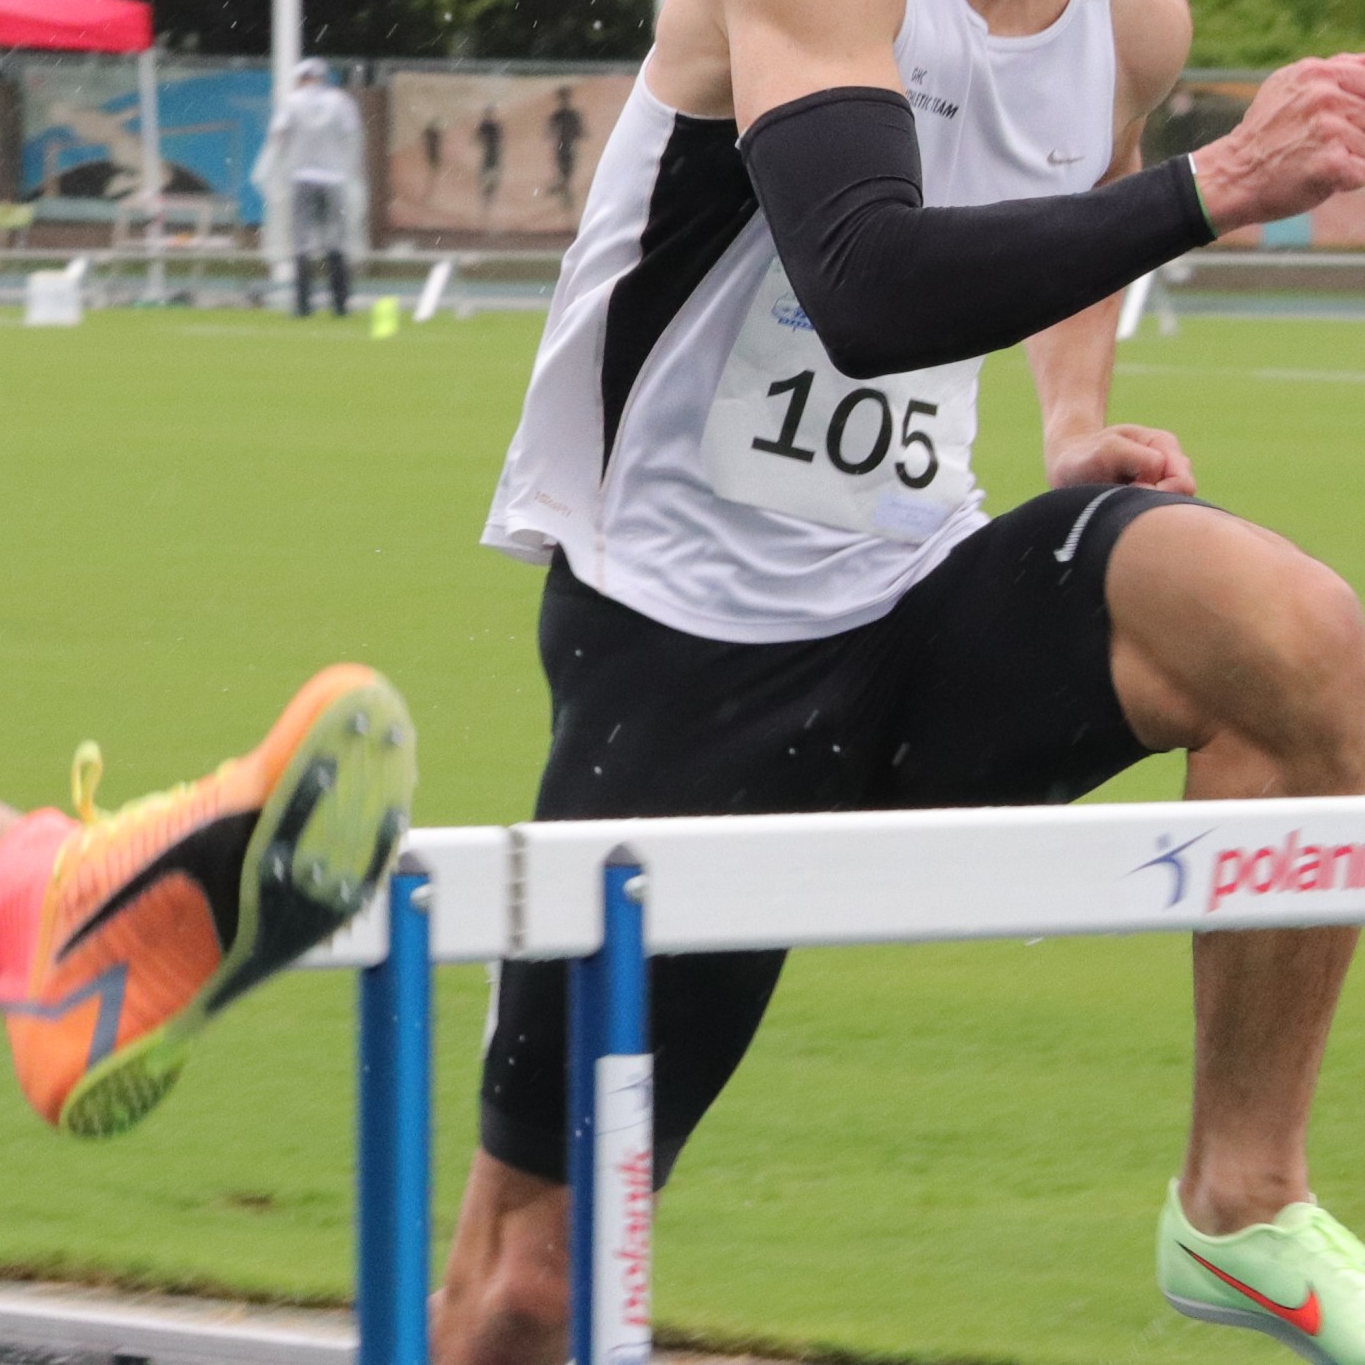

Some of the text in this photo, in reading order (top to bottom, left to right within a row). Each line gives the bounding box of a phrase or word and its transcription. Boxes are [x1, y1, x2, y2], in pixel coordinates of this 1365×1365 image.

[751, 369, 940, 489] 105
[1205, 828, 1365, 915] polan
[614, 1148, 652, 1327] polanik
